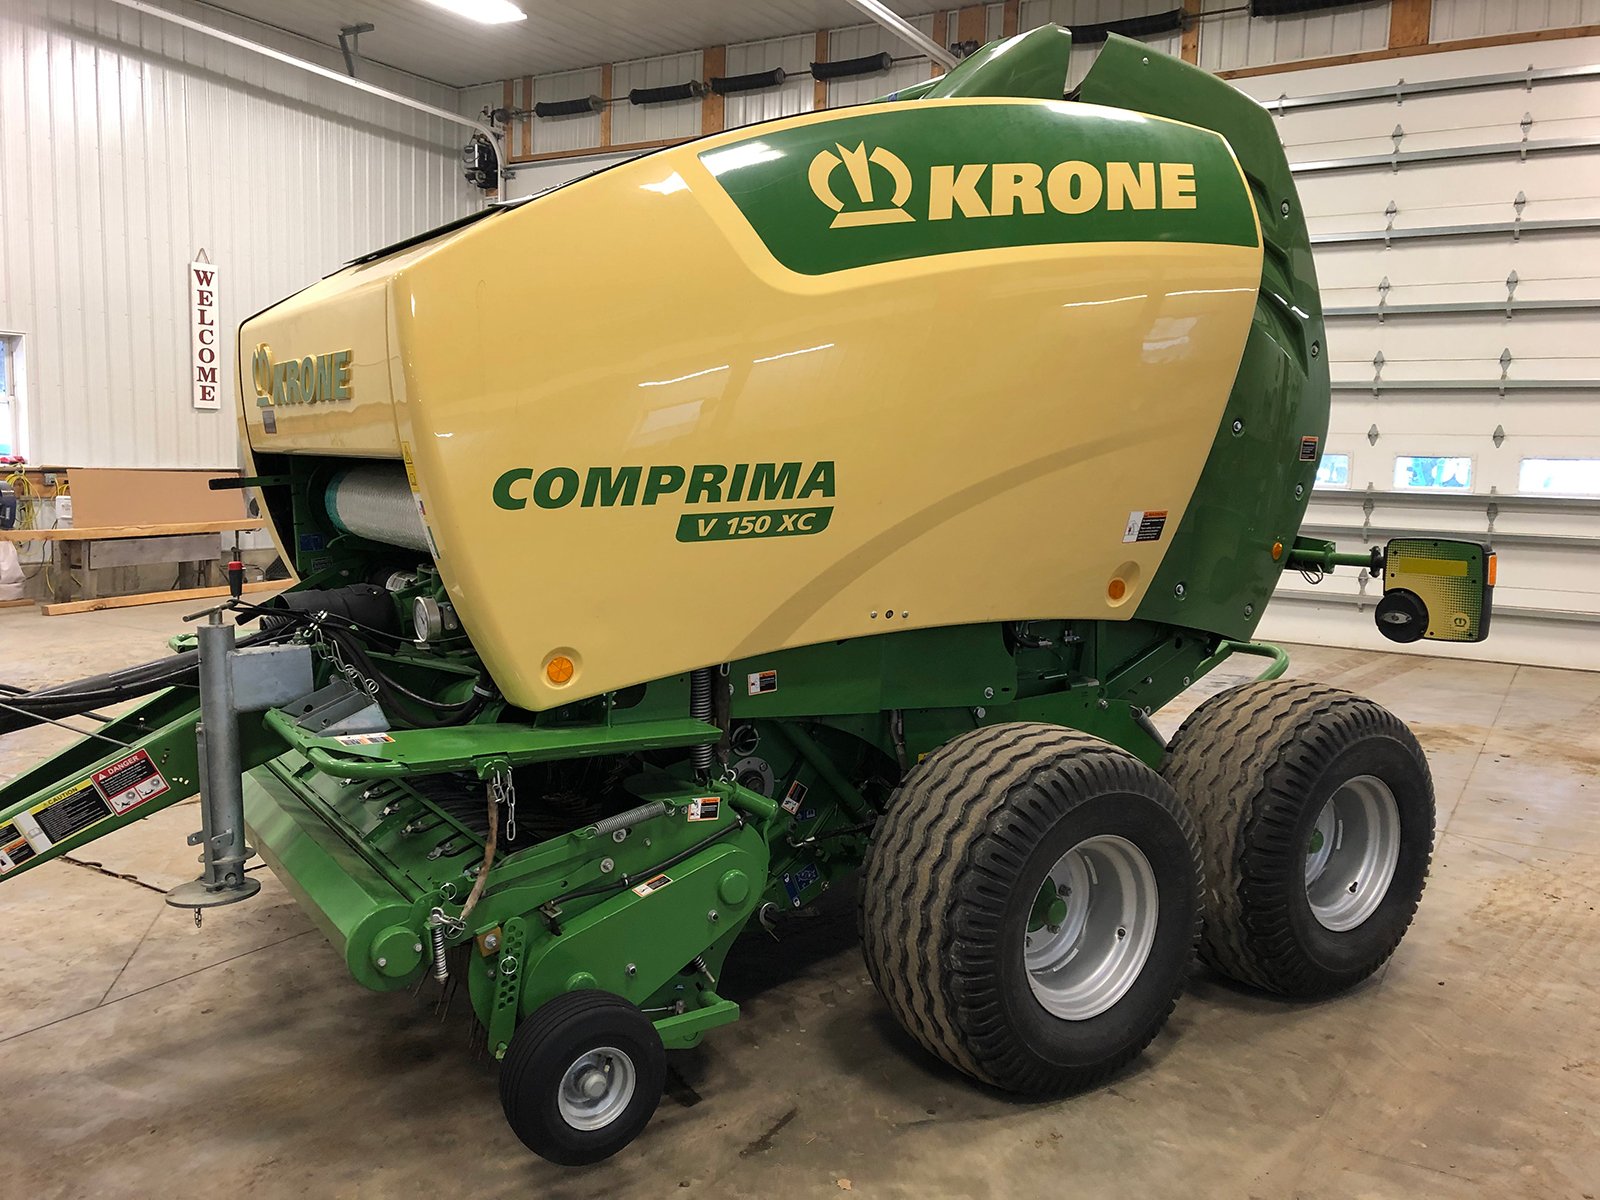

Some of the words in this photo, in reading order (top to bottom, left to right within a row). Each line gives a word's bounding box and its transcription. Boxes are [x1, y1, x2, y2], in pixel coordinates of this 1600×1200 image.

[928, 160, 1197, 221] KRONE
[193, 268, 218, 402] WELCOME
[272, 348, 353, 405] KRONE
[492, 460, 836, 511] COMPRIMA
[697, 517, 718, 537] V
[726, 515, 772, 536] 150
[777, 512, 817, 532] XC
[107, 755, 140, 775] DANGER
[47, 786, 78, 806] CAUTION
